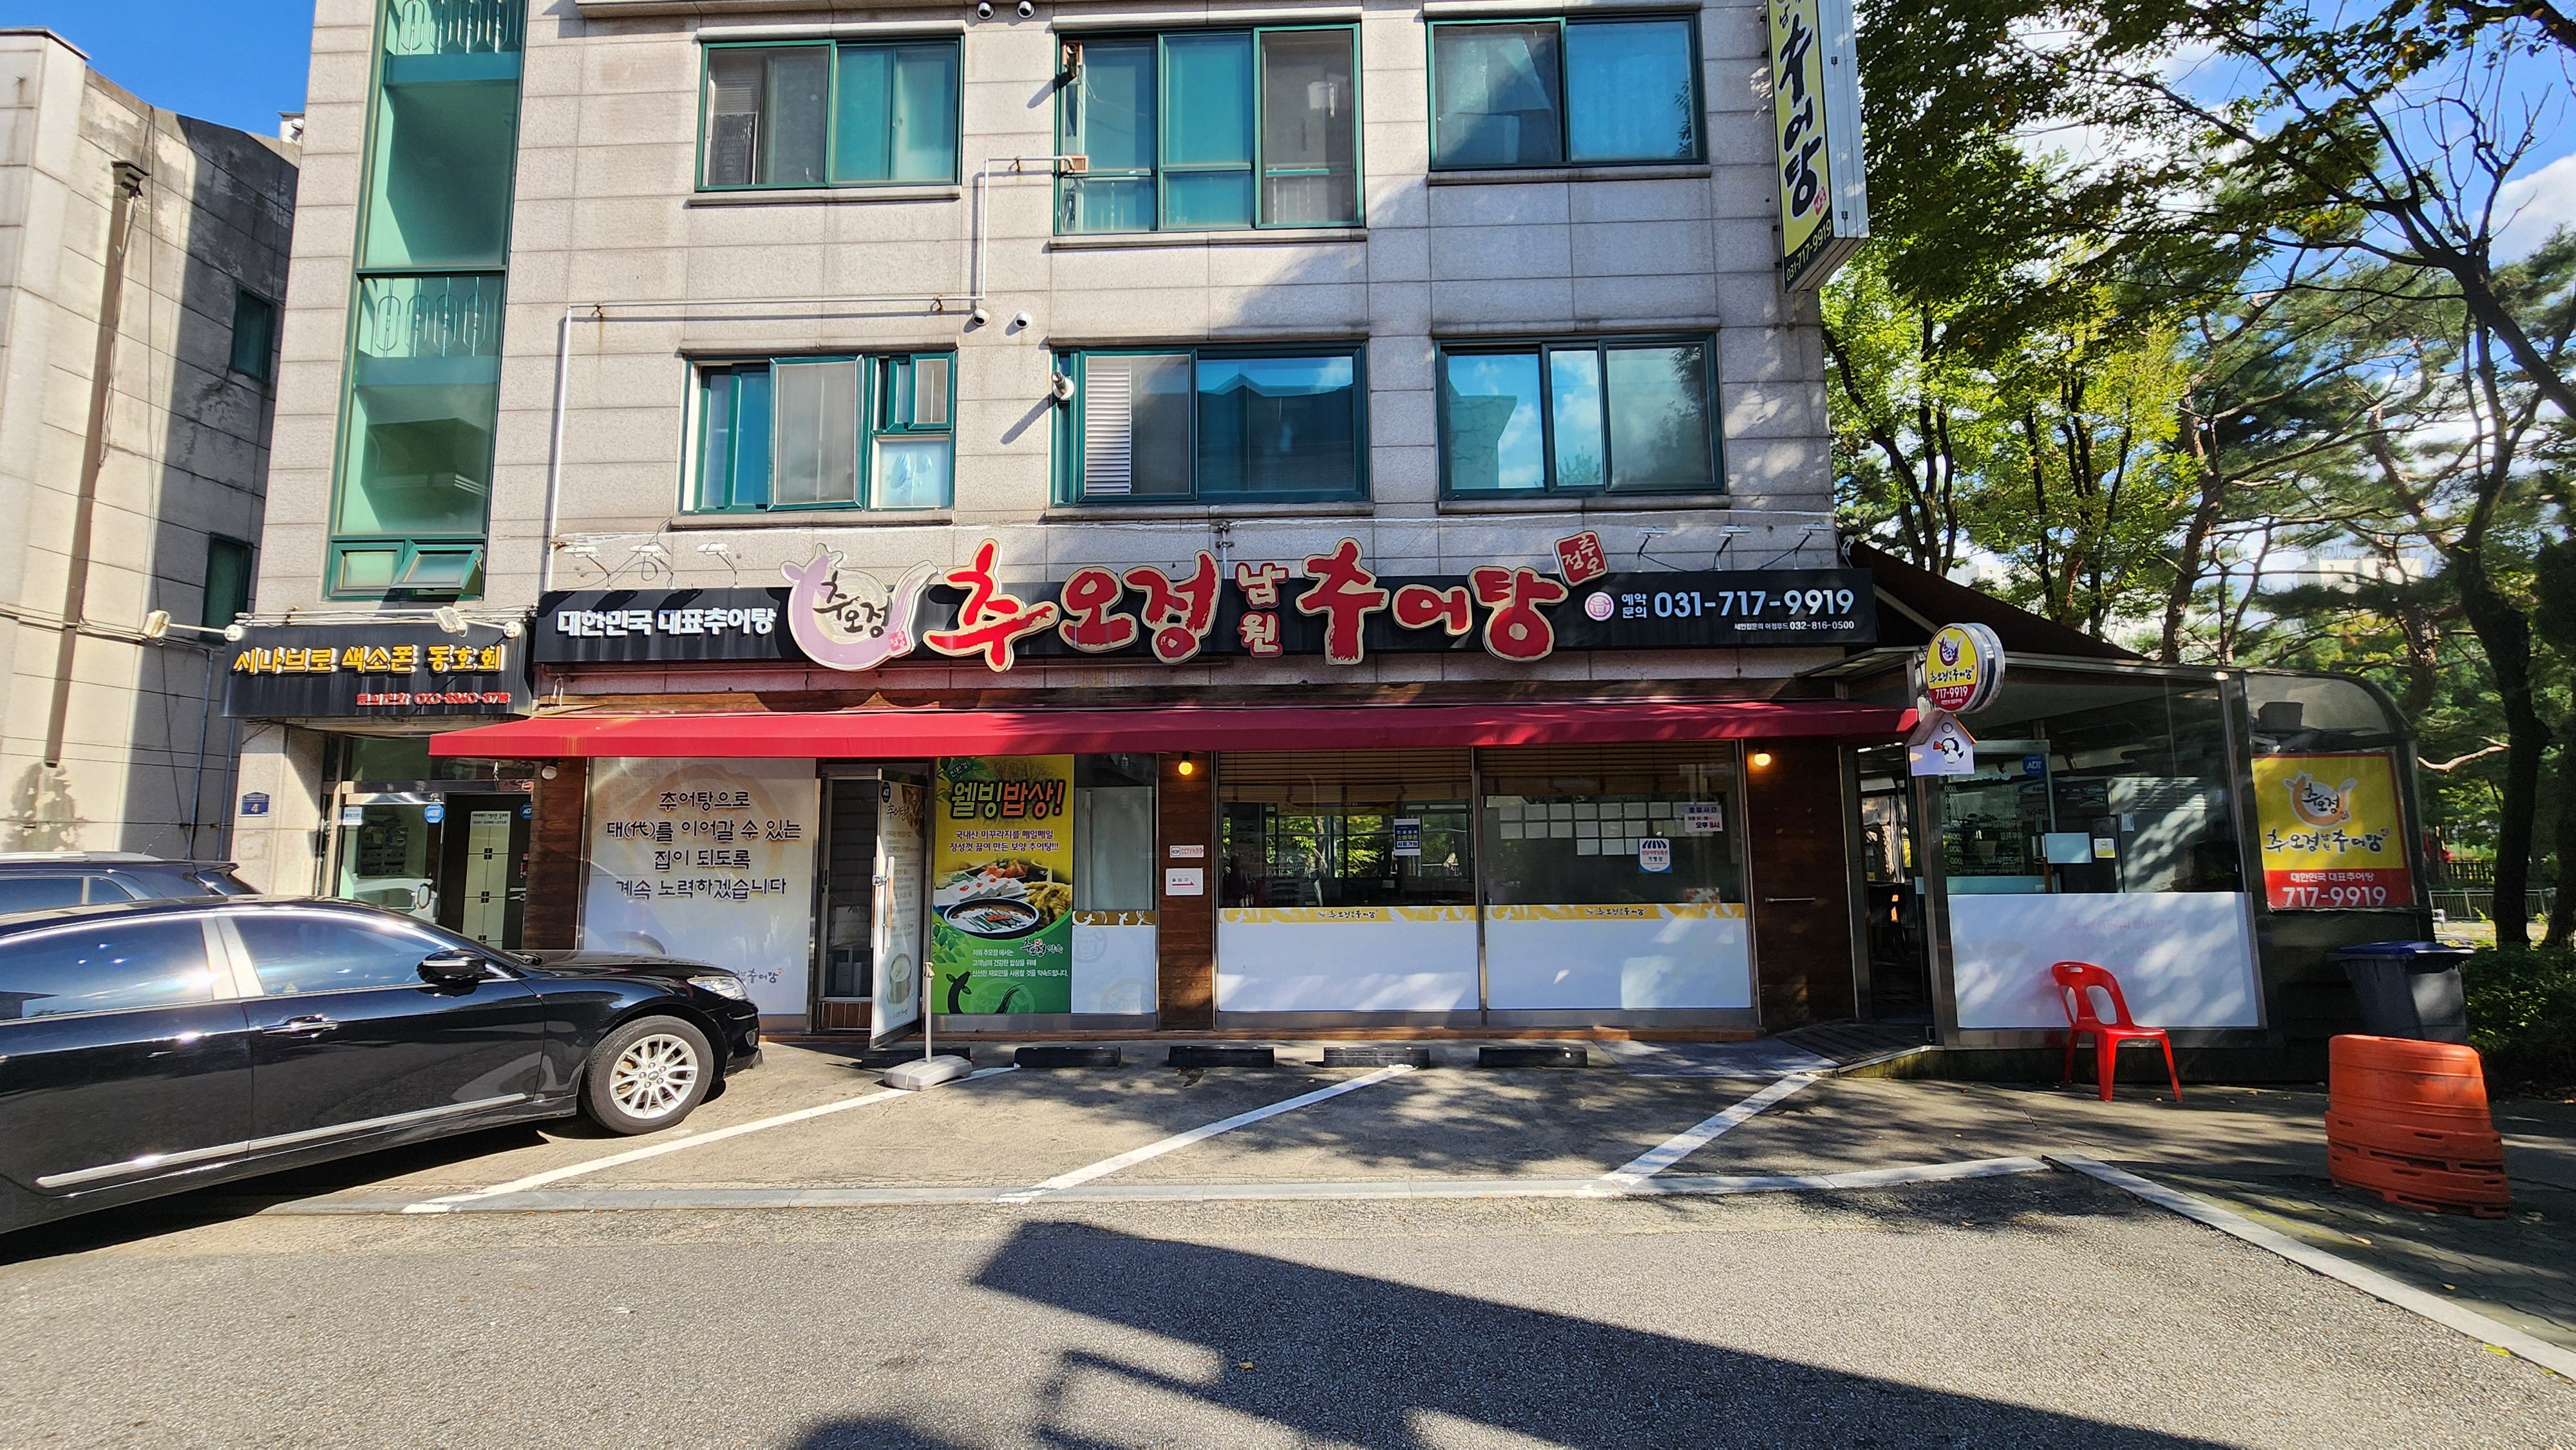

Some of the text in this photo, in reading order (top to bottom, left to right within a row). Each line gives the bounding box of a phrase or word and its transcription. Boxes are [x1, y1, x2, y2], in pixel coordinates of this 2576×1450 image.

[1779, 13, 1823, 218] 추어탕
[1786, 219, 1832, 281] 031-717-9919
[1236, 561, 1289, 657] 남원
[1296, 537, 1569, 666] 추어탕
[1621, 593, 1647, 606] 예약
[1654, 589, 1855, 617] 031-717-9919
[558, 607, 775, 636] 대한민국 대표추어탕
[1622, 607, 1647, 619] 문의
[1789, 621, 1855, 630] 032-816-0500
[232, 645, 505, 673] 시나브로 색소폰 동호회
[1935, 686, 1968, 700] 717-9919
[950, 761, 969, 778] 친환경
[251, 803, 259, 813] 4
[659, 791, 752, 812] 추어탕으로
[951, 781, 1064, 818] 웰빙밥상!
[606, 820, 802, 842] 대(代)를 이어갈 수 있는
[955, 829, 1054, 840] 국내산 미꾸라지를 매일매일
[975, 842, 990, 852] 끓여
[992, 842, 1009, 851] 만든
[1011, 842, 1027, 851] 보양
[654, 849, 752, 871] 집이 되도록
[2290, 872, 2374, 883] 대한민국 대표추어탕
[616, 878, 787, 900] 계속 노력하겠습니다
[2282, 886, 2387, 907] 717-9919
[1047, 945, 1063, 954] 약속
